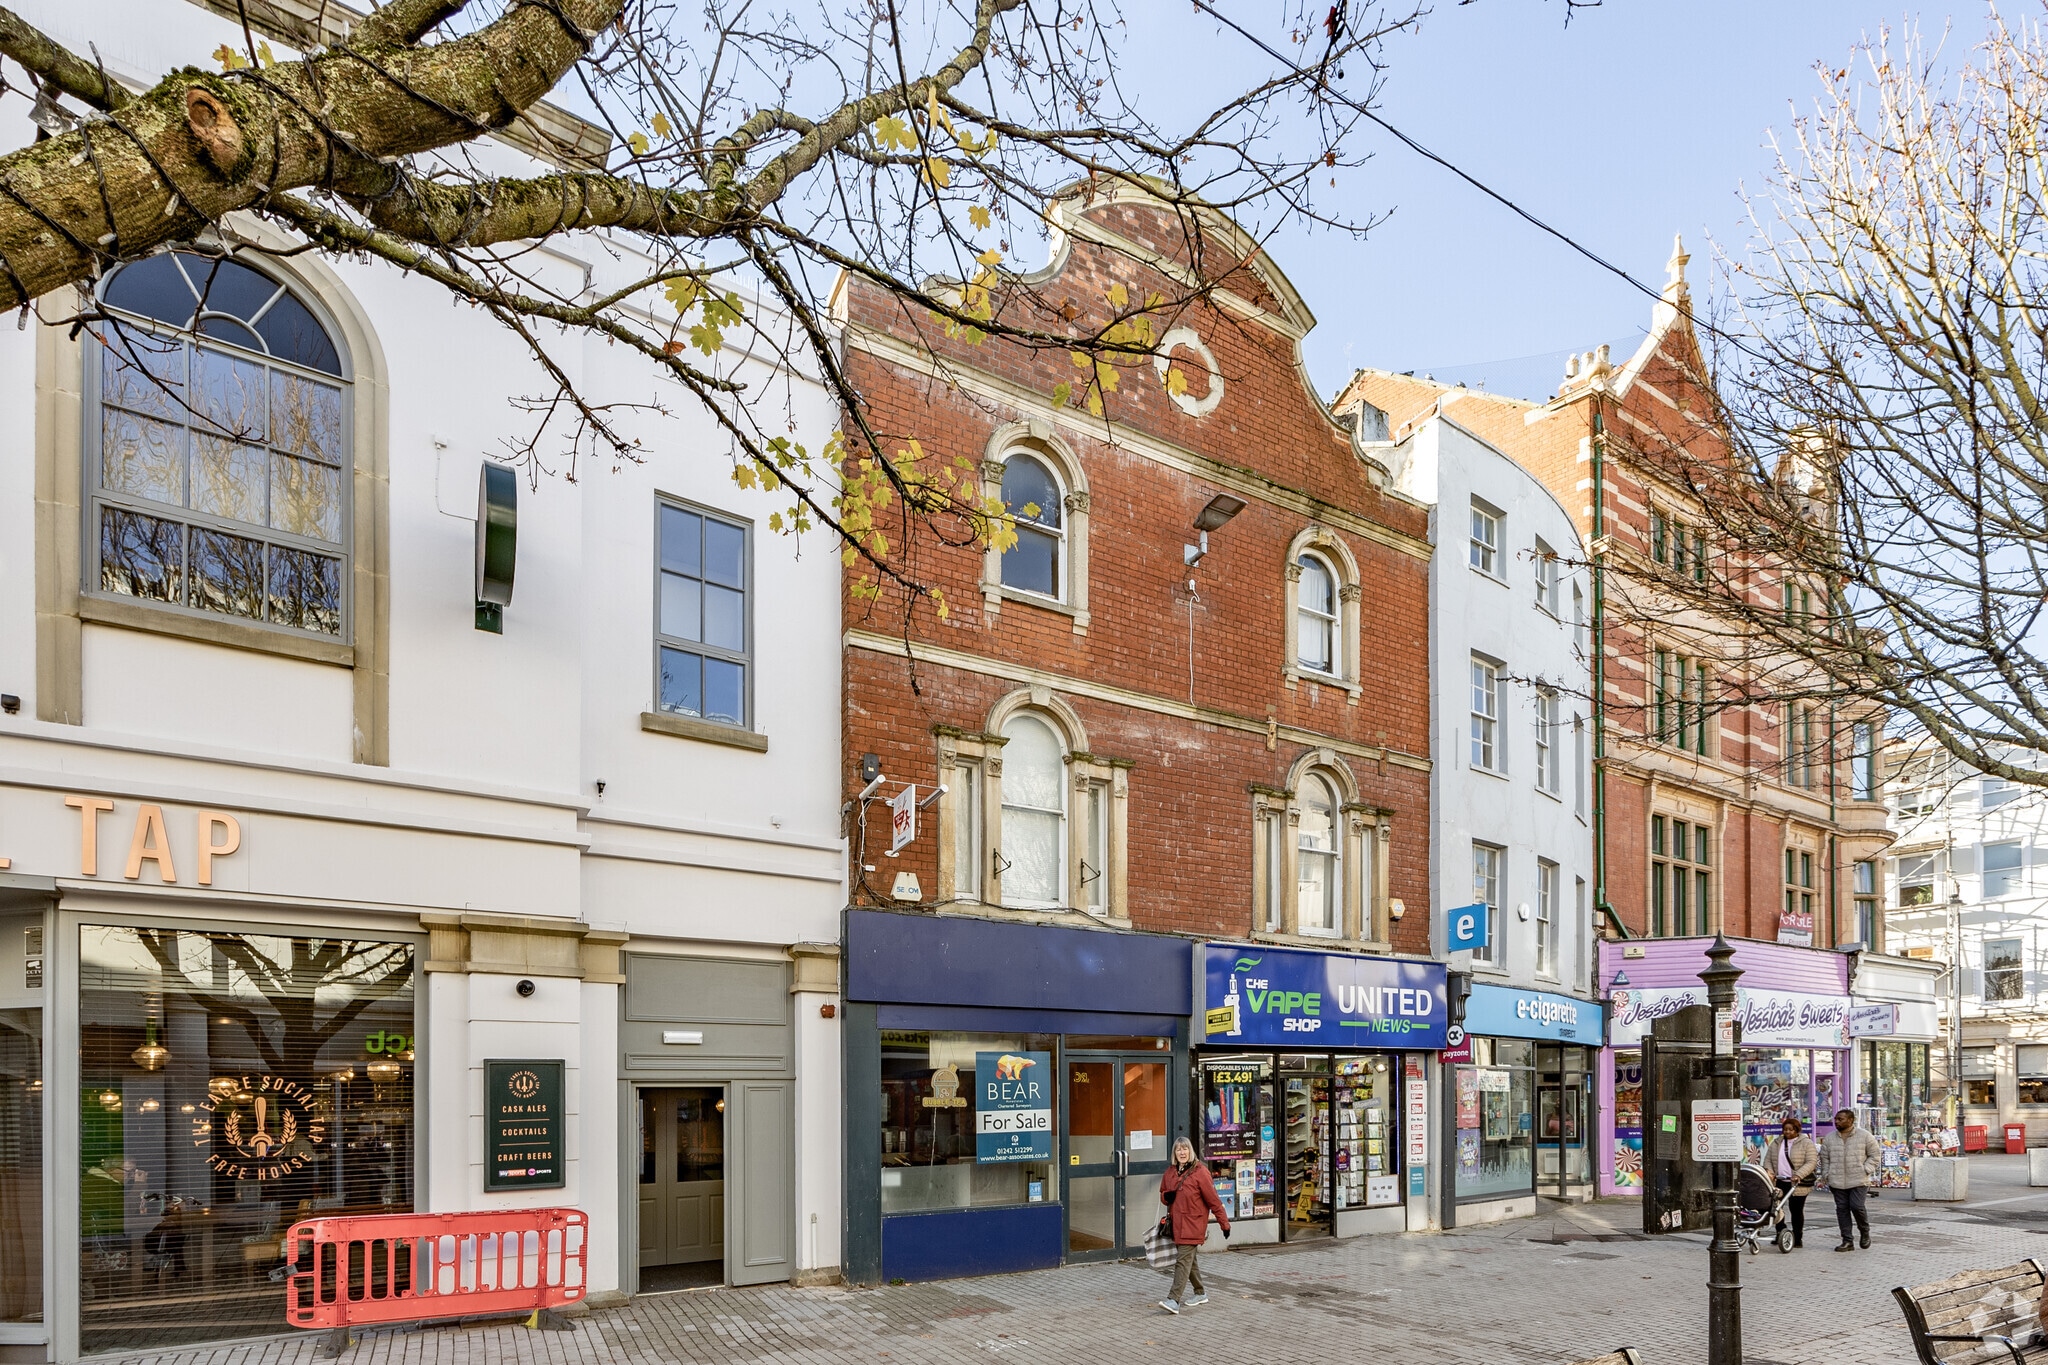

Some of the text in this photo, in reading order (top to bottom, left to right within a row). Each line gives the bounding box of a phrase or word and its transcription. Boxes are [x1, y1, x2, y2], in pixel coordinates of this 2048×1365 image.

[64, 795, 241, 885] TAP
[896, 886, 919, 895] SEOM
[1456, 914, 1475, 941] e
[1246, 978, 1268, 989] THE
[1246, 989, 1321, 1016] VAPE
[1338, 985, 1433, 1016] UNITED
[1621, 991, 1696, 1026] Jessica's
[1516, 995, 1578, 1027] e-cigarette
[1800, 1001, 1844, 1028] Sweets
[1283, 1018, 1321, 1032] SHOP
[1372, 1019, 1411, 1034] NEWS
[1442, 1049, 1469, 1059] payzone
[988, 1082, 1041, 1100] BEAR
[191, 1075, 325, 1147] THE EAGLE SOCIAL TAP
[502, 1104, 547, 1113] CASK ALES
[983, 1113, 1046, 1130] For Sale
[502, 1127, 547, 1136] COCKTAILS
[205, 1151, 312, 1180] FREE HOUSE
[497, 1151, 552, 1162] CRAFT BEERS
